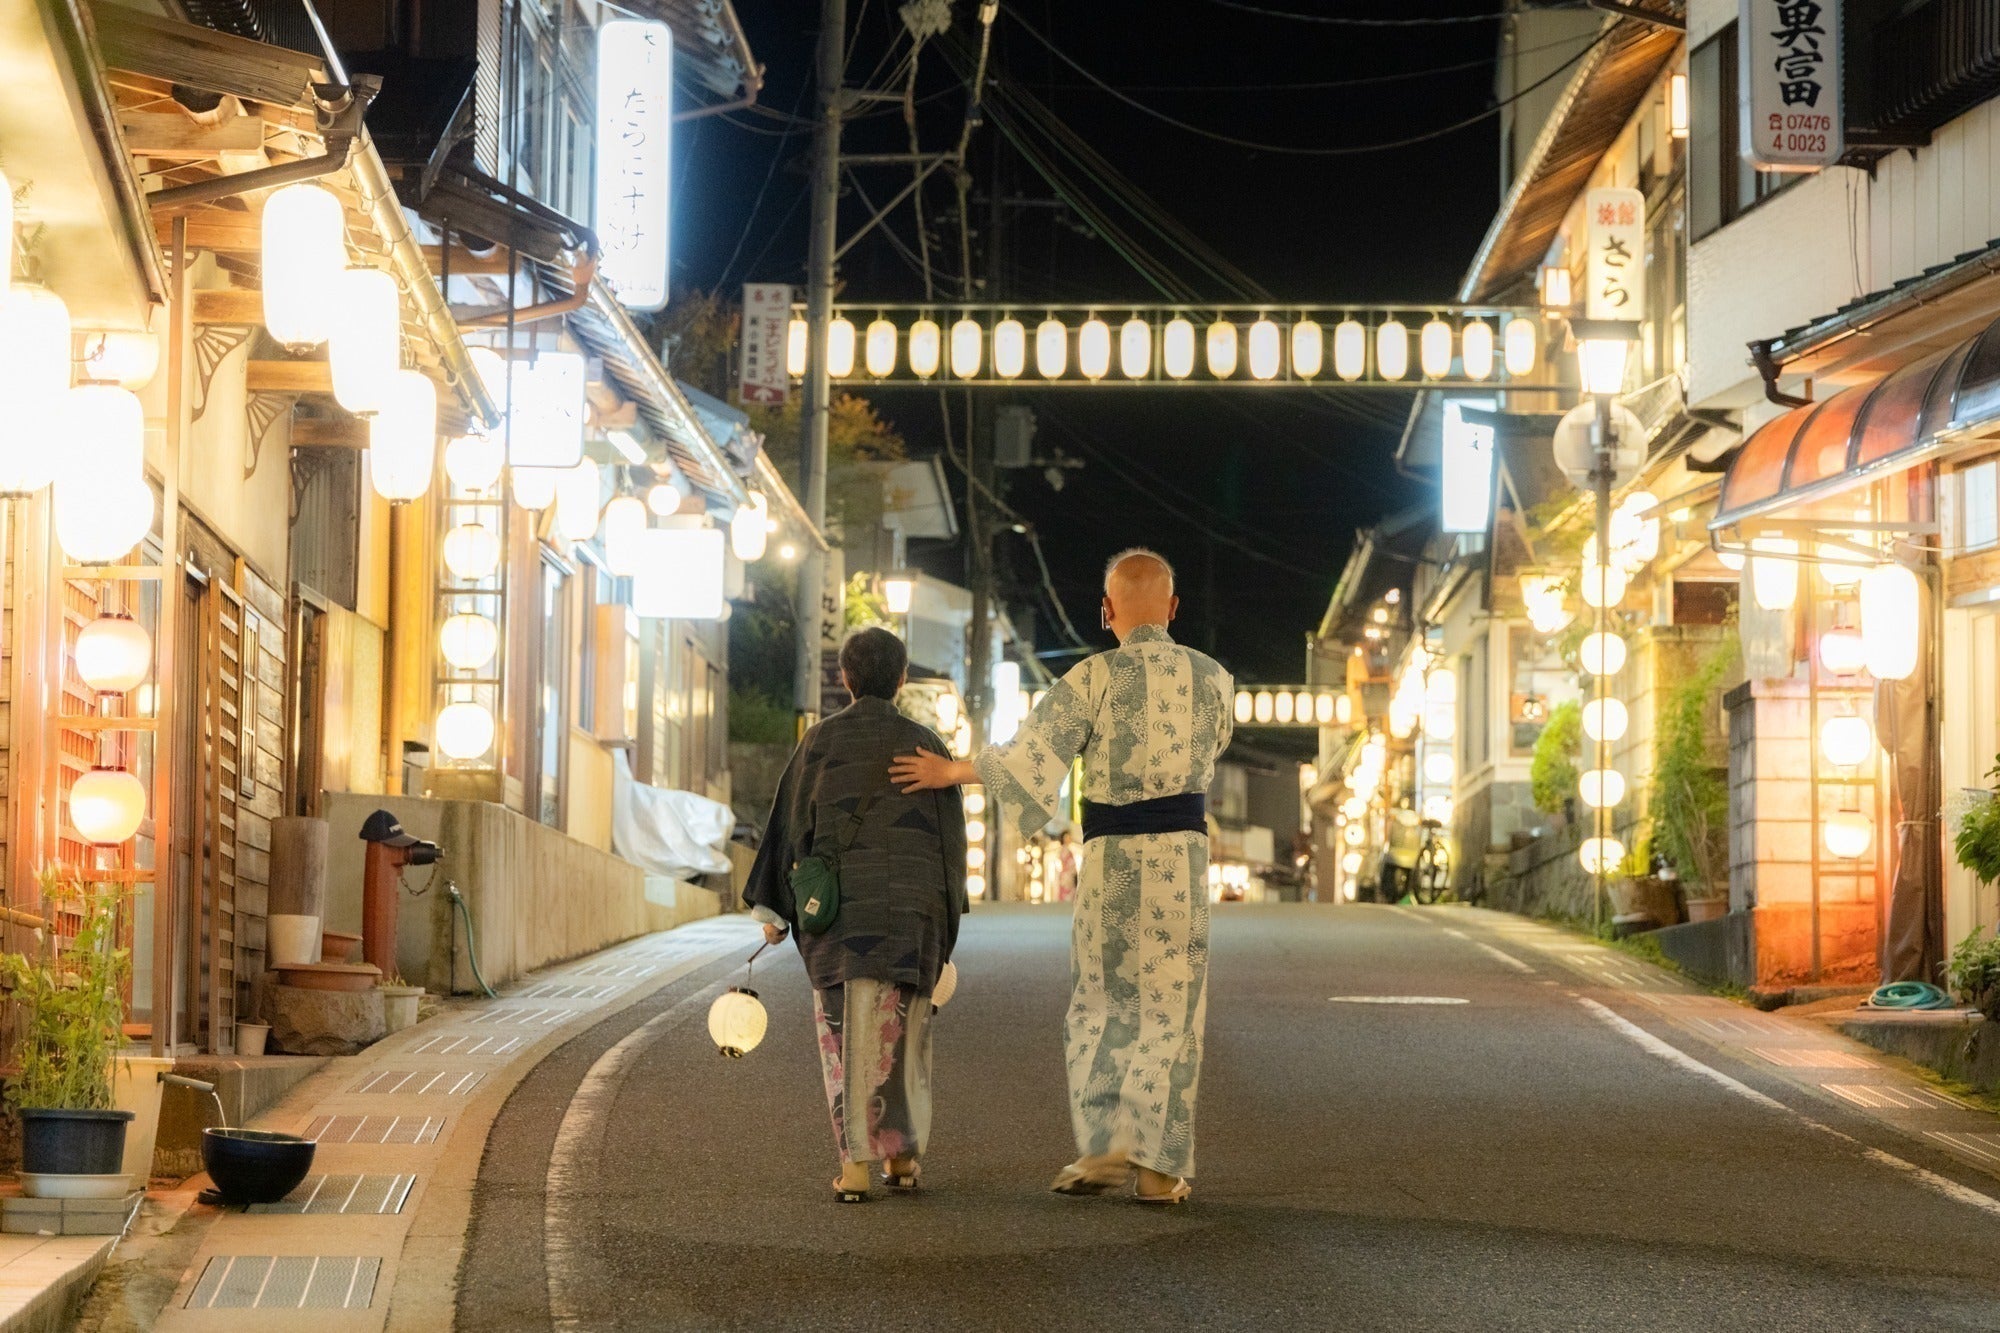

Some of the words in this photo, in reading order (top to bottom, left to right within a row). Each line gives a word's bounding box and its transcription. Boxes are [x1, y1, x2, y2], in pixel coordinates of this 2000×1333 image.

[1786, 114, 1831, 131] 07476
[1773, 134, 1783, 151] 4
[1787, 134, 1827, 153] 0023
